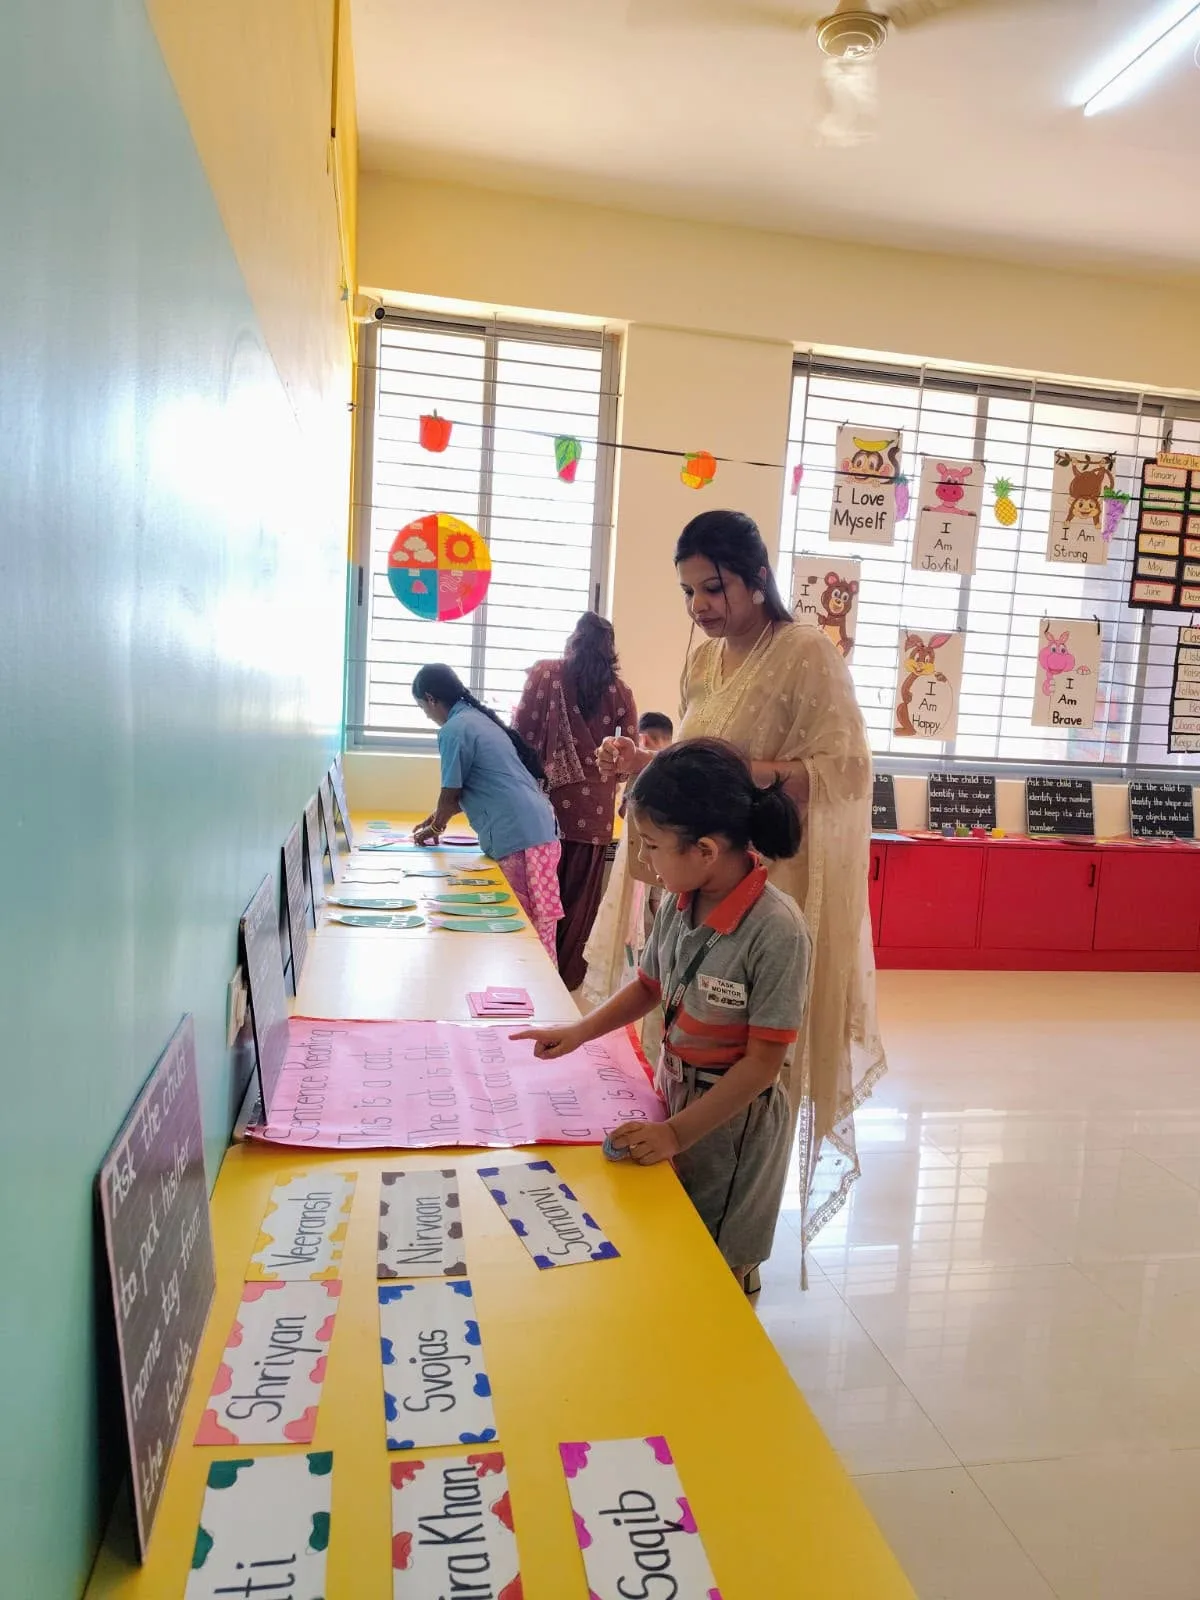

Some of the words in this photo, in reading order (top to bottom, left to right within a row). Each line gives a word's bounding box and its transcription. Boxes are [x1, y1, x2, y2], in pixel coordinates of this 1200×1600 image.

[833, 485, 842, 504] I
[851, 488, 885, 506] Love
[834, 509, 887, 535] Myself
[940, 522, 952, 534] I
[1061, 527, 1069, 541] I
[1077, 529, 1095, 542] Am
[1148, 536, 1166, 548] April
[933, 539, 953, 551] Am
[1054, 544, 1088, 563] Strong
[921, 555, 959, 571] Joyful
[1147, 561, 1163, 573] May
[800, 584, 810, 596] I
[794, 599, 817, 614] Am
[925, 681, 936, 696] I
[1066, 678, 1074, 689] I
[918, 698, 937, 712] Am
[1057, 694, 1077, 706] Am
[912, 713, 941, 735] Happy
[1052, 711, 1083, 726] Brave
[930, 773, 942, 782] Ask
[946, 773, 959, 783] the
[961, 775, 979, 784] child
[984, 775, 992, 784] to
[1027, 777, 1040, 787] Ask
[1043, 778, 1053, 787] the
[1056, 778, 1072, 788] child
[1075, 780, 1082, 788] to
[930, 788, 955, 801] identify
[958, 790, 968, 798] the
[972, 790, 990, 799] colour
[1146, 783, 1157, 791] the
[1160, 783, 1176, 792] child
[1177, 783, 1185, 792] to
[1029, 792, 1052, 805] identify
[1056, 793, 1067, 802] the
[1069, 793, 1091, 803] number
[1131, 796, 1151, 809] identify
[1153, 796, 1163, 806] the
[1165, 796, 1181, 810] shape
[930, 804, 942, 813] and
[943, 804, 959, 813] sort
[960, 804, 971, 813] the
[971, 805, 992, 818] object
[1030, 807, 1042, 816] and
[1044, 807, 1060, 822] keep
[1063, 809, 1073, 817] its
[1076, 808, 1092, 818] after
[1145, 811, 1167, 824] objects
[1169, 811, 1190, 822] related
[1030, 822, 1056, 832] number.
[1141, 826, 1153, 835] the
[711, 986, 742, 998] MONITOR
[717, 980, 735, 989] TASK
[283, 1029, 348, 1070] Reading
[403, 1042, 451, 1061] fat.
[464, 1045, 506, 1064] sat
[348, 1047, 393, 1071] cat.
[419, 1067, 452, 1079] is
[465, 1069, 512, 1088] cat
[593, 1062, 636, 1084] my
[363, 1080, 392, 1088] a
[353, 1097, 392, 1108] is
[406, 1086, 457, 1107] cat
[602, 1089, 637, 1101] is
[263, 1075, 328, 1141] Sentence
[468, 1093, 519, 1115] fat
[111, 1140, 137, 1219] Ask
[141, 1097, 161, 1150] the
[163, 1050, 187, 1116] child
[338, 1116, 392, 1144] This
[407, 1113, 462, 1144] The
[474, 1122, 528, 1139] A
[561, 1128, 592, 1137] a
[120, 1266, 137, 1319] to
[140, 1193, 160, 1296] pick
[160, 1135, 190, 1217] his/her
[519, 1186, 593, 1257] Samanvi
[267, 1190, 333, 1269] Veeransh
[397, 1196, 444, 1265] Nirvaan
[131, 1328, 162, 1421] name
[162, 1269, 180, 1325] tag
[181, 1205, 200, 1271] from
[225, 1315, 323, 1423] Shriyan
[402, 1329, 471, 1413] Svojas
[142, 1438, 163, 1511] the
[166, 1338, 192, 1425] table.
[418, 1466, 486, 1545] Khan
[598, 1490, 685, 1600] Saqib
[213, 1553, 296, 1600] ti
